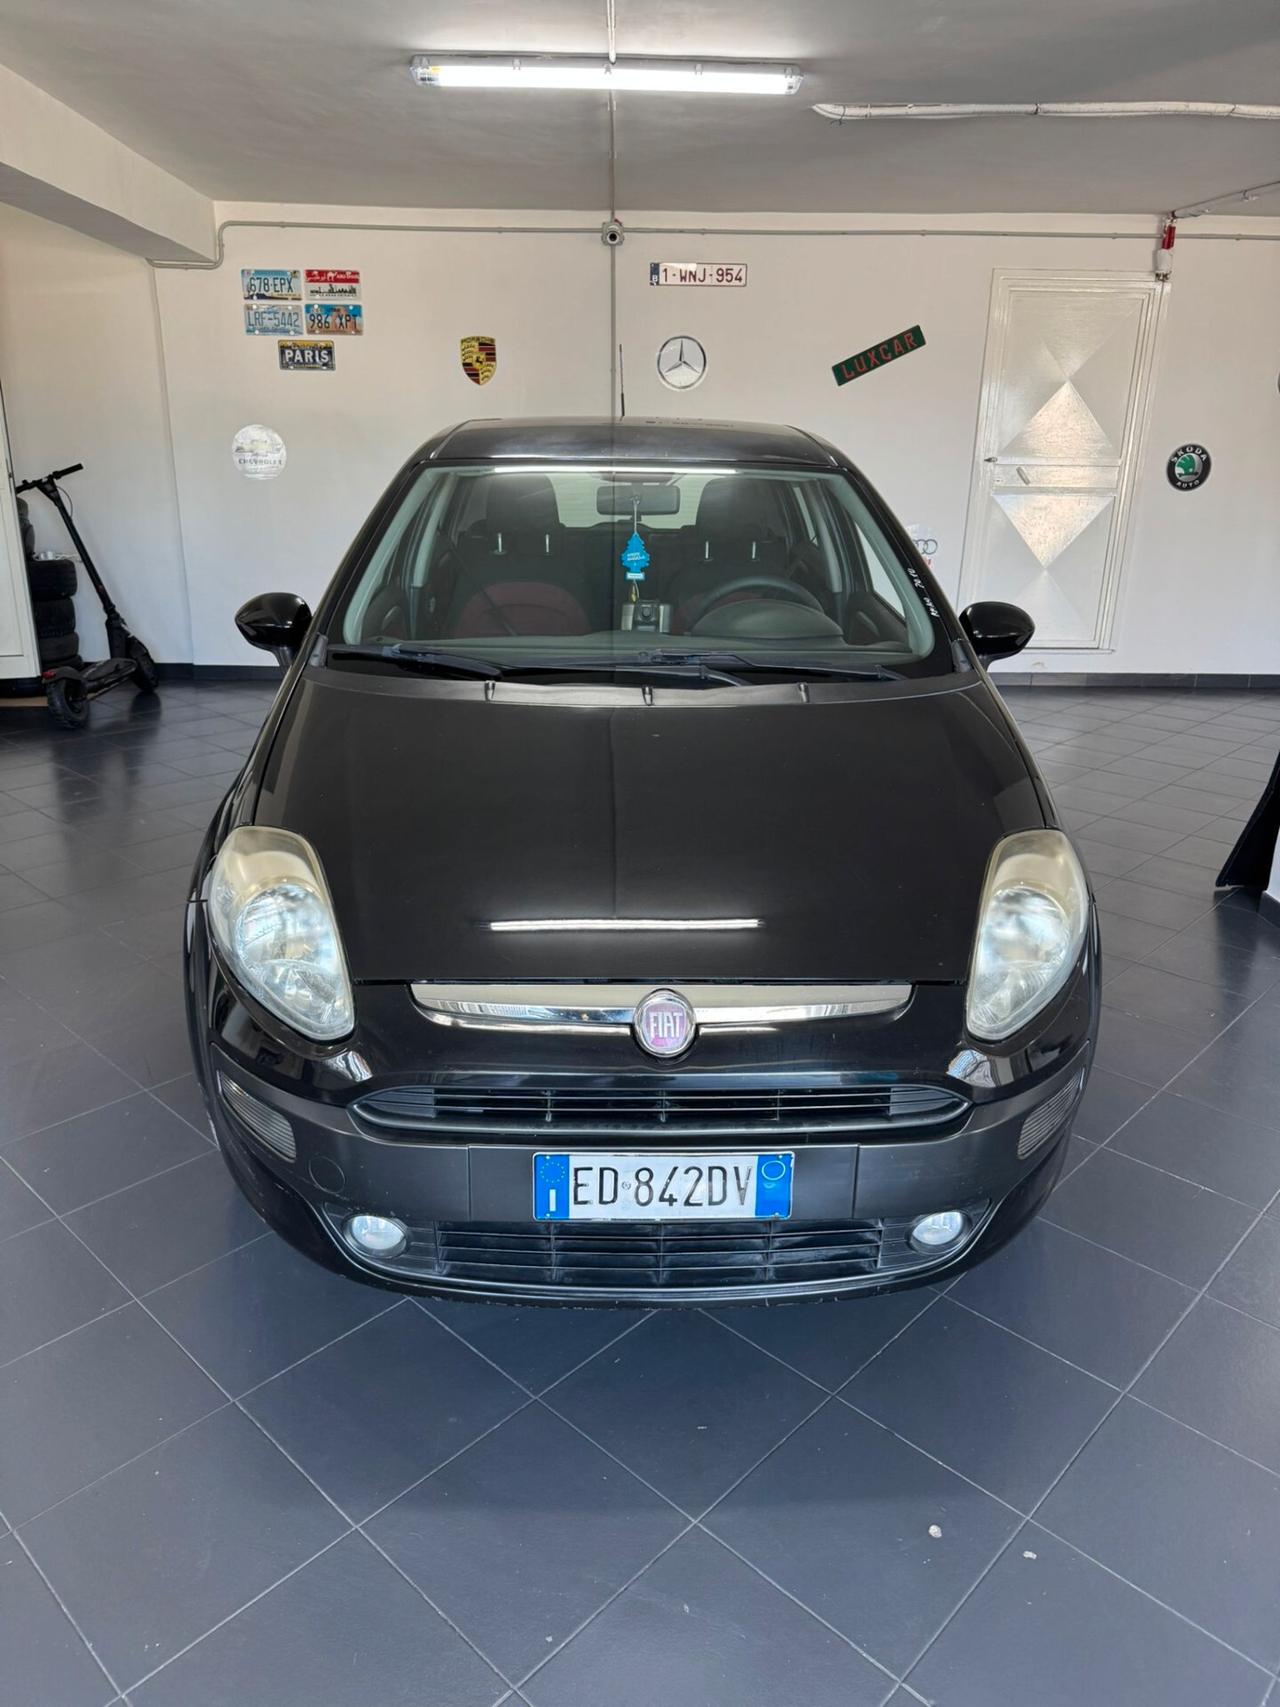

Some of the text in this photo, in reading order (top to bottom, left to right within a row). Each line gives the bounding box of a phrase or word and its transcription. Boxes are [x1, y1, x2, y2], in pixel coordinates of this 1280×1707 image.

[309, 313, 357, 329] 986 XPT
[285, 349, 330, 363] PARIS
[841, 332, 918, 379] LUXCAR
[1175, 480, 1200, 489] AUTO
[649, 1011, 684, 1038] FIAT
[572, 1165, 754, 1208] ED 842DV
